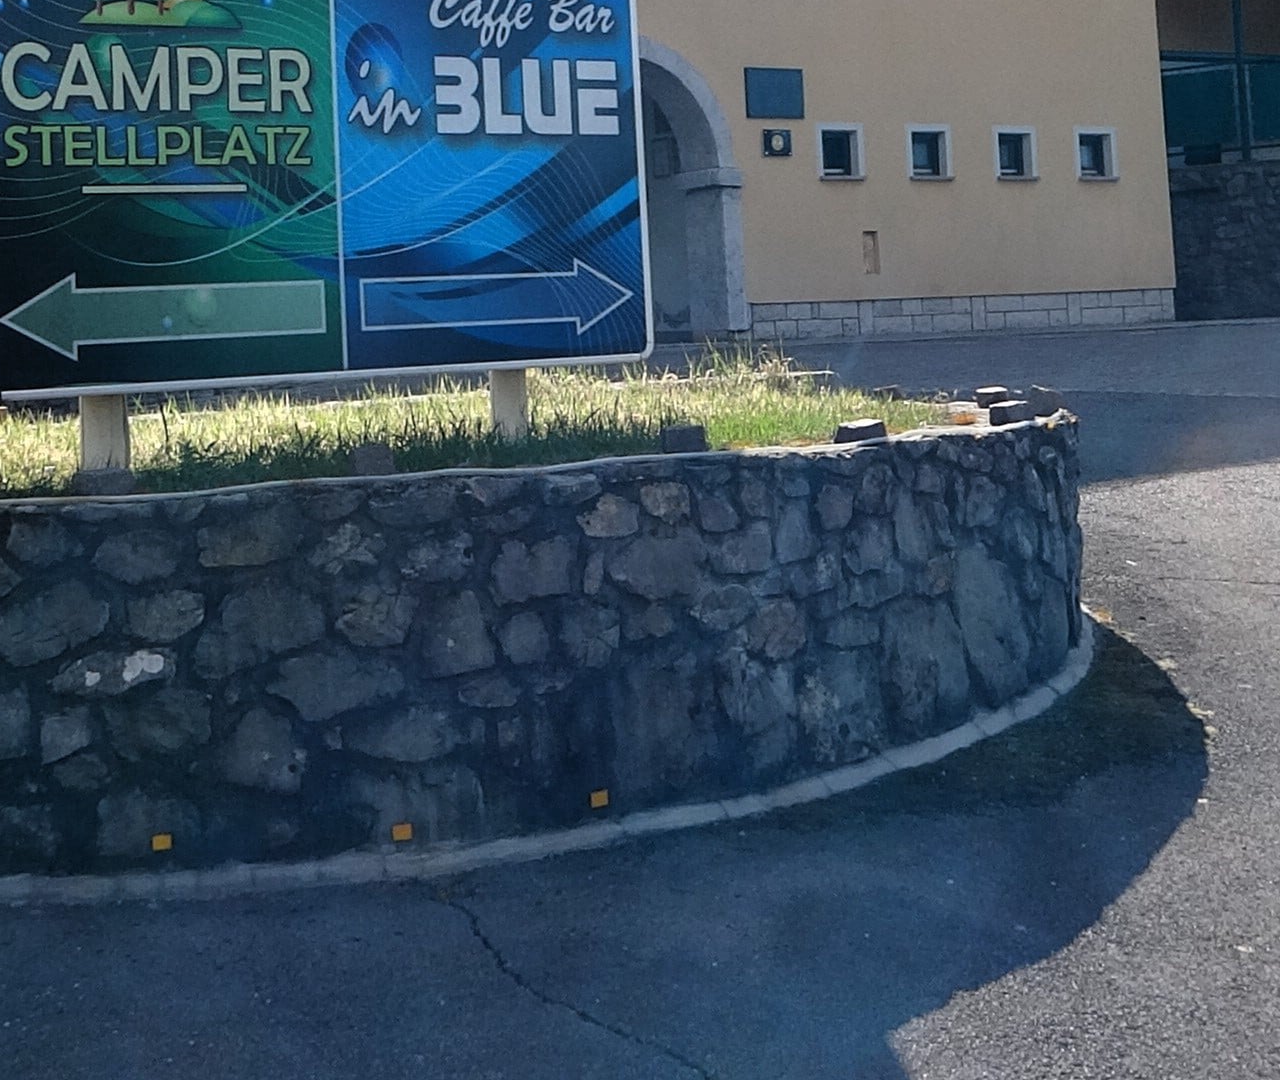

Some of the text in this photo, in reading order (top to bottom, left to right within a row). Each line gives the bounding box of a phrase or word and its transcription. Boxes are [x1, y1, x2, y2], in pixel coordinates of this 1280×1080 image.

[1, 41, 313, 113] CAMPER
[433, 55, 620, 135] BLUE
[3, 124, 312, 167] STELLPLATZ
